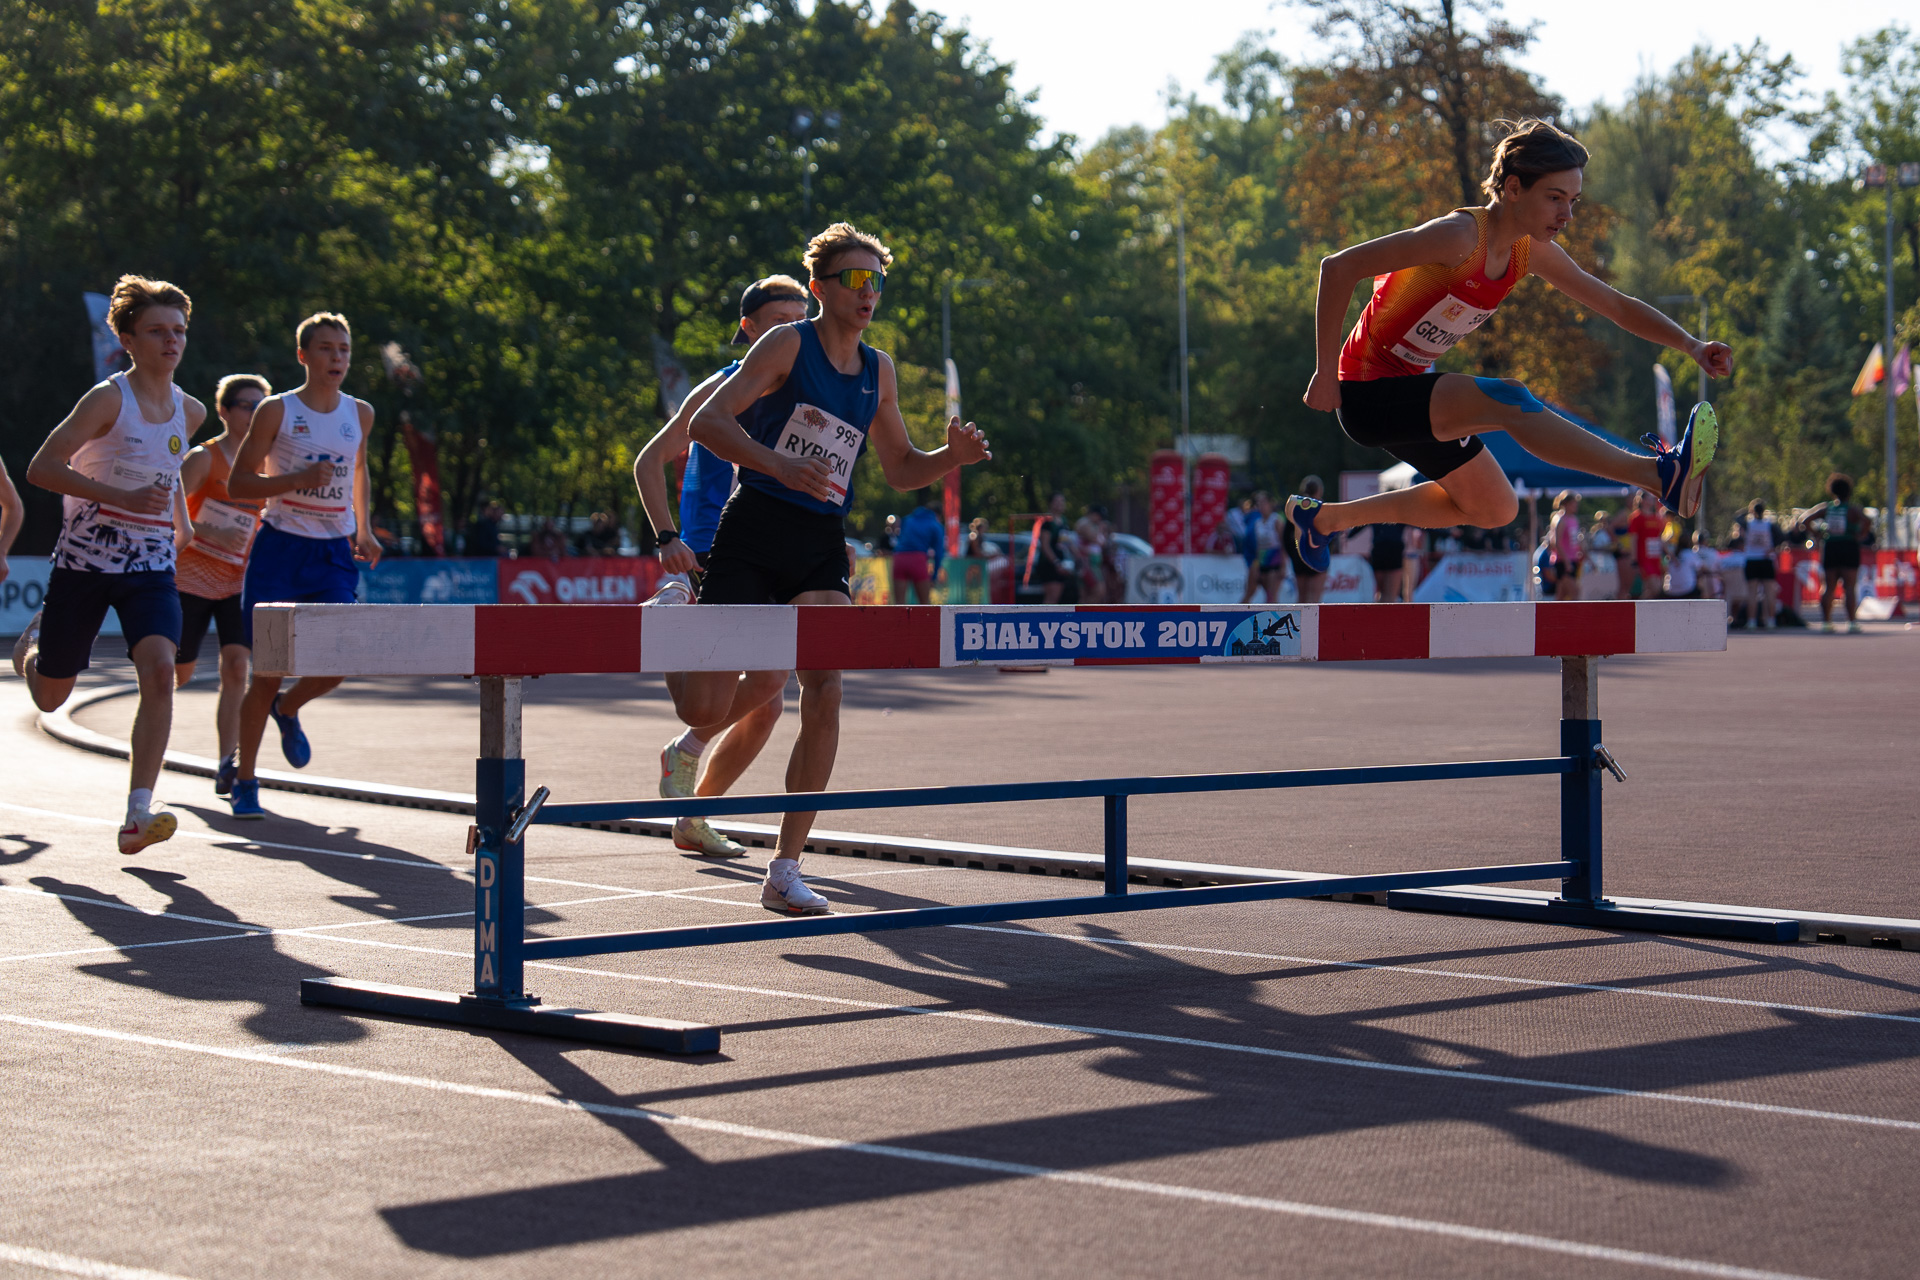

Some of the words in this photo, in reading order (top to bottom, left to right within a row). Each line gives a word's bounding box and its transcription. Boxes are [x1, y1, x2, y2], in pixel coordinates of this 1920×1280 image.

[835, 425, 858, 448] 995
[153, 471, 174, 487] 216
[295, 486, 344, 500] WALAS
[0, 581, 45, 611] PO
[555, 575, 636, 601] ORLEN
[962, 621, 1146, 650] BIAŁYSTOK
[1158, 620, 1228, 648] 2017
[479, 857, 497, 985] DIMA
